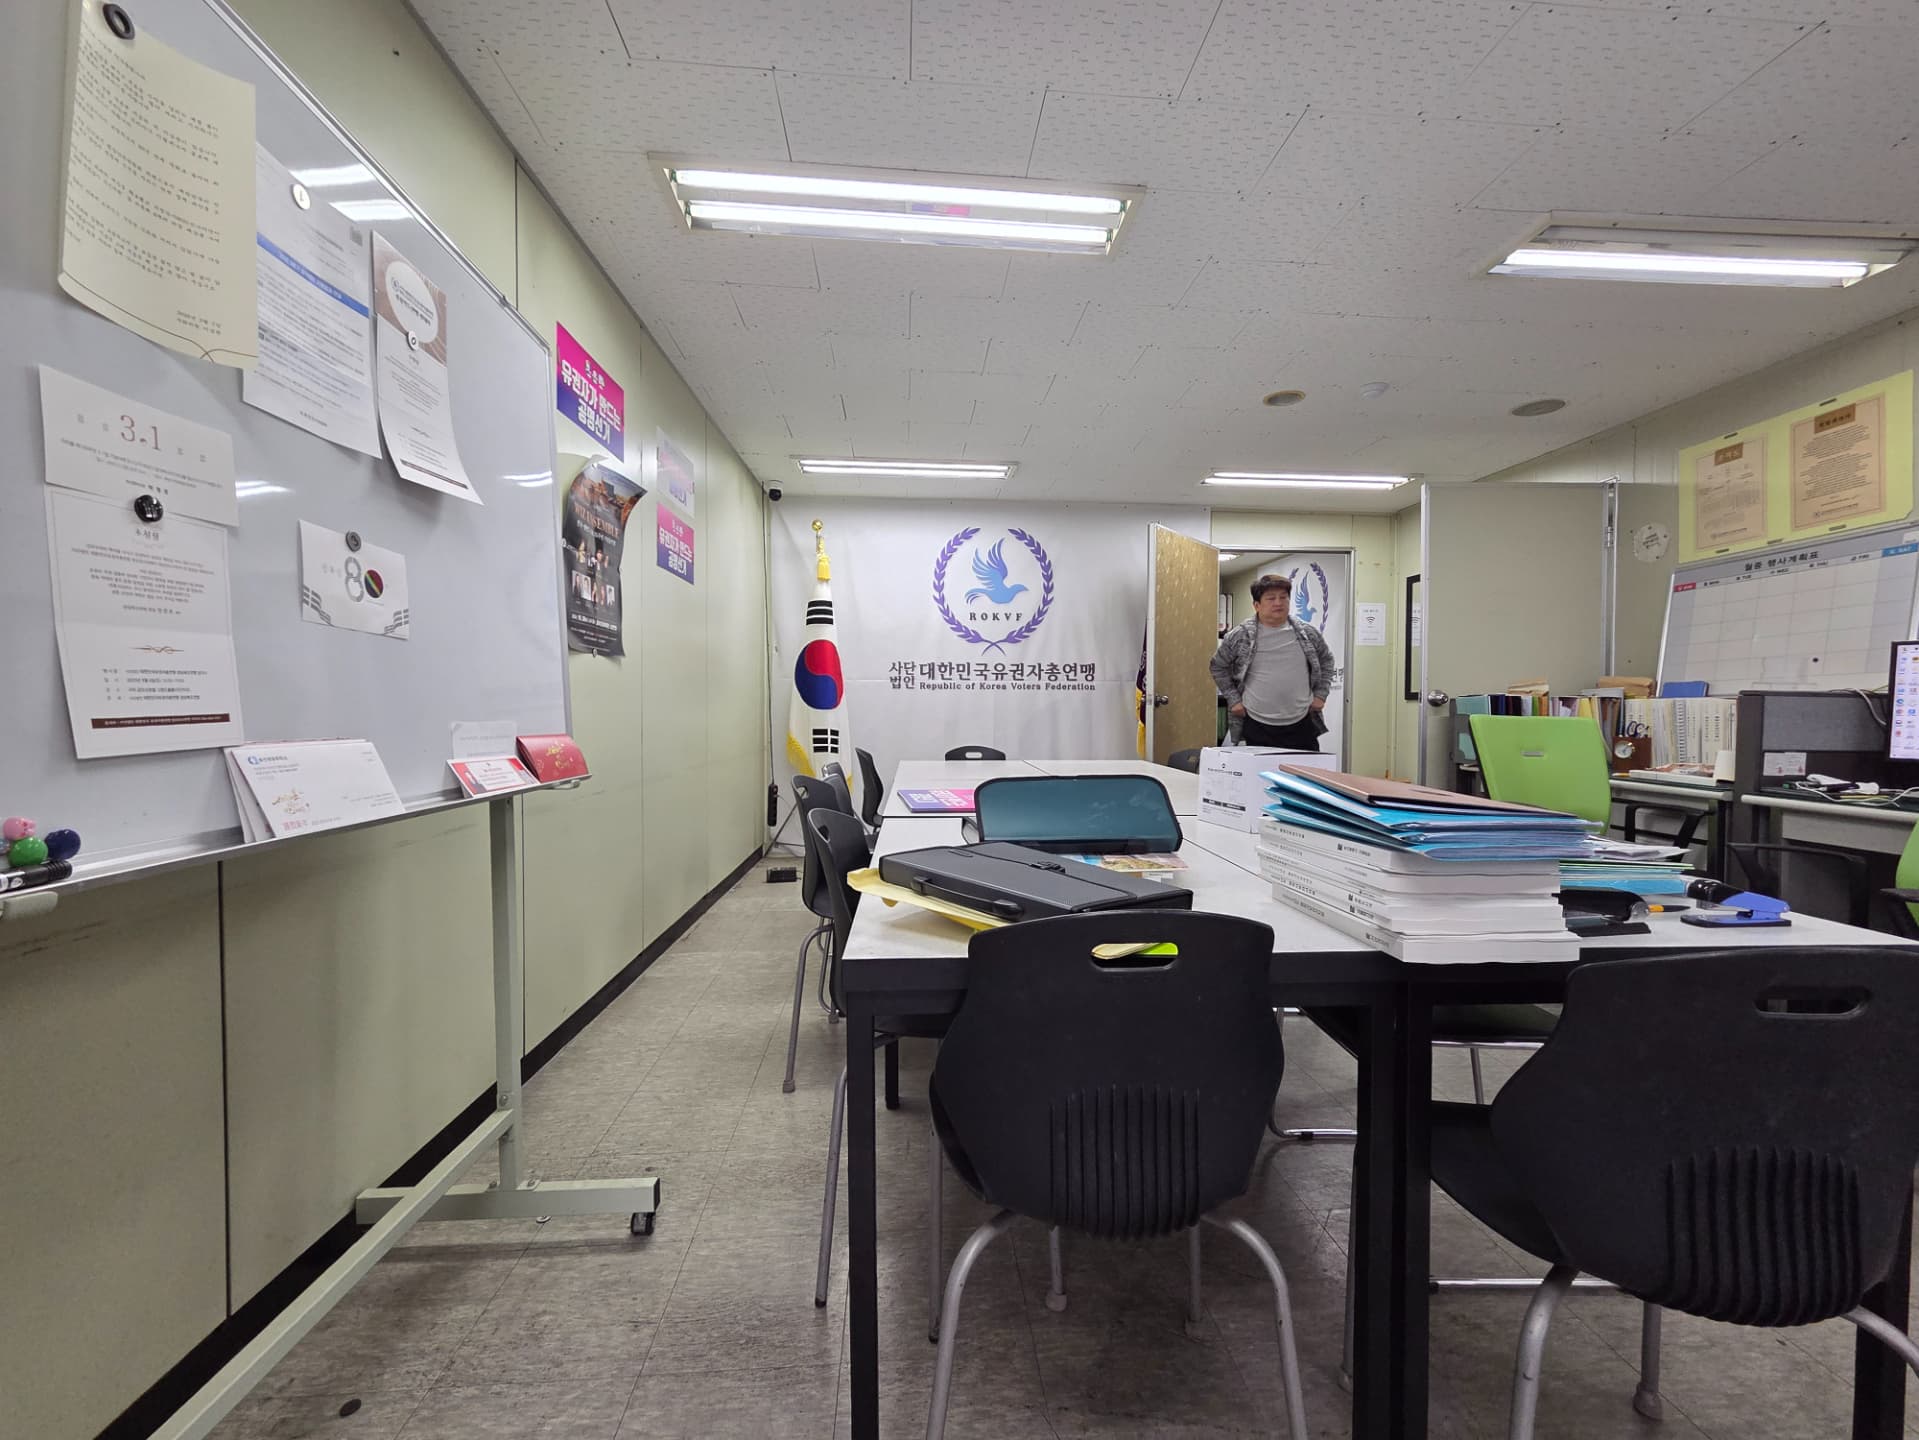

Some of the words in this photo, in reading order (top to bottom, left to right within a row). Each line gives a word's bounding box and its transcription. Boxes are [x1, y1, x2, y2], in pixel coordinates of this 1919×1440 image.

[561, 360, 598, 409] 유권자가
[599, 392, 621, 432] 만드는
[578, 398, 611, 445] 공명선거
[120, 414, 161, 451] 3.1
[969, 612, 1024, 621] ROKVF
[889, 661, 915, 675] 사단
[919, 662, 1096, 681] 대한민국유권자총연맹
[889, 675, 915, 689] 법인
[919, 682, 962, 691] Republic
[965, 682, 975, 690] of
[979, 682, 1007, 690] Korea
[1011, 682, 1041, 690] Voters
[1045, 682, 1096, 691] Federation
